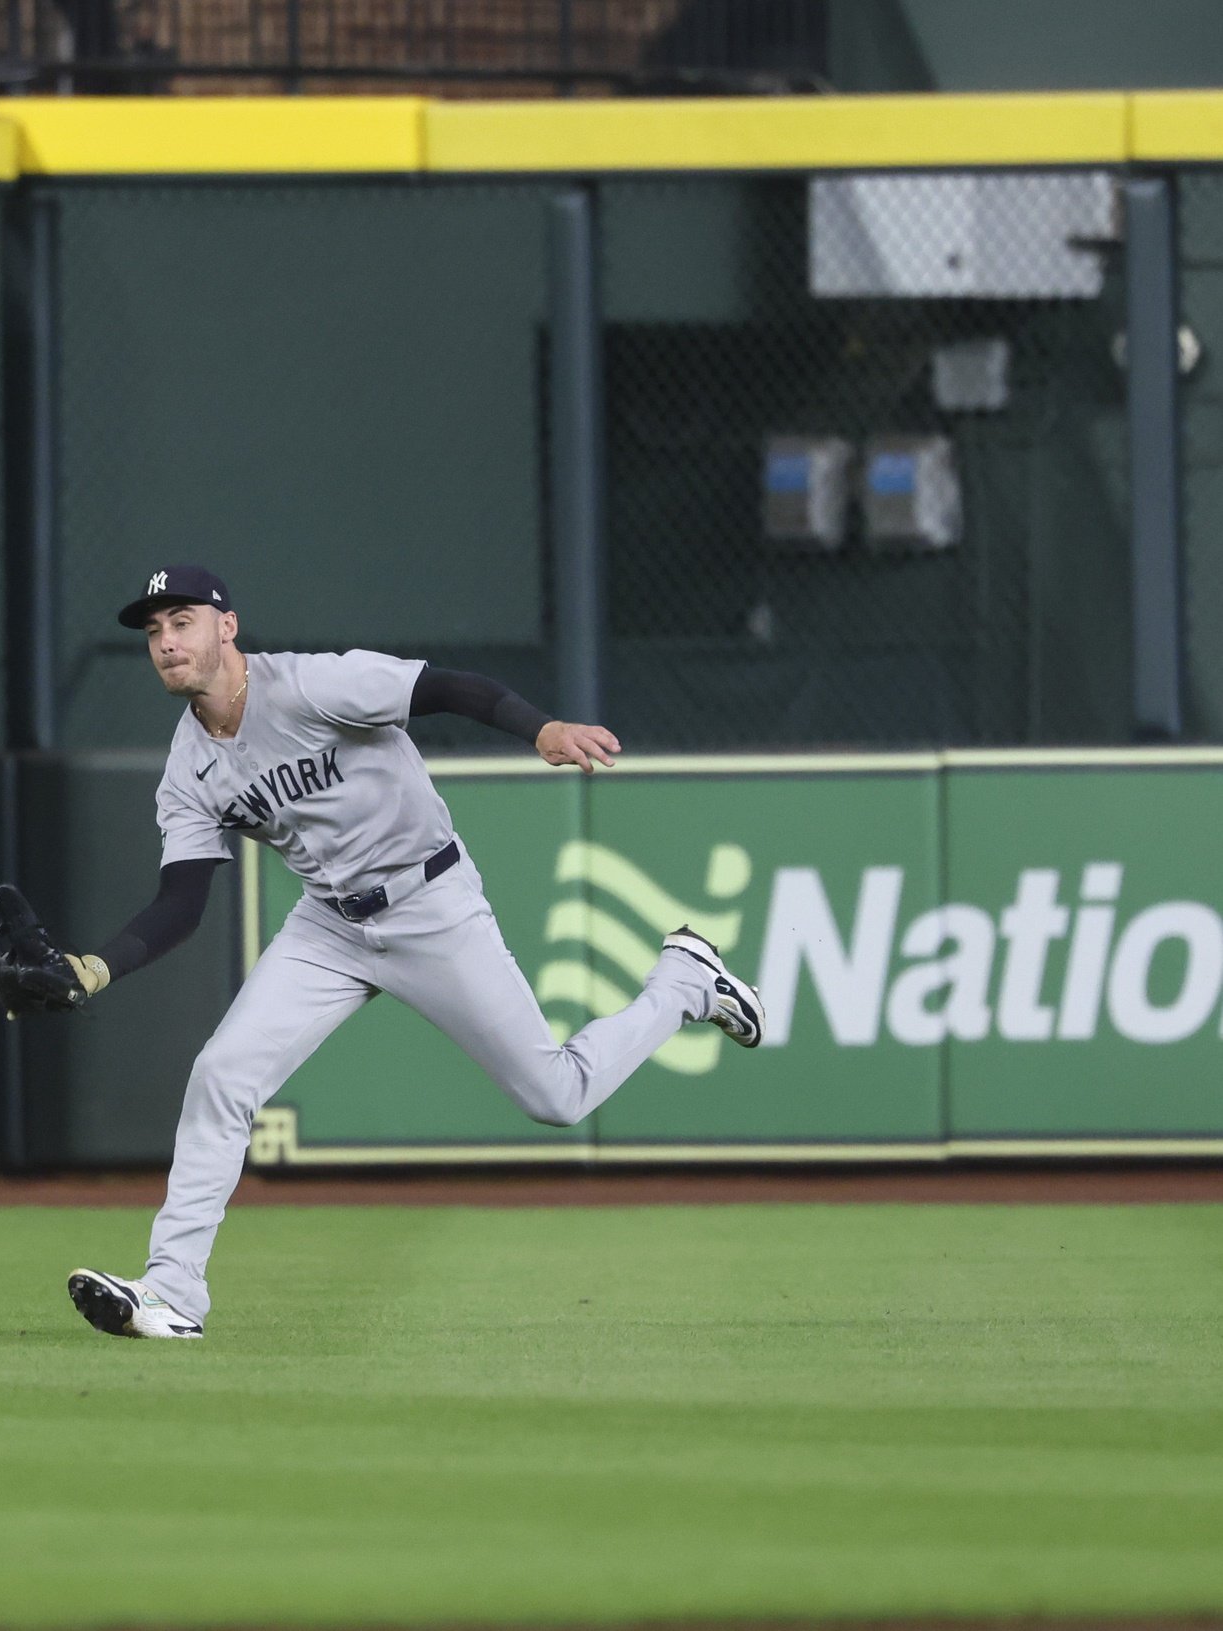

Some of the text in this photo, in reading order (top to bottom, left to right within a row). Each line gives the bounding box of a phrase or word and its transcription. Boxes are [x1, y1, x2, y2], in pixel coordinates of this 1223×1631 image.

[147, 570, 169, 596] NY
[259, 746, 345, 808] YORK
[758, 861, 1223, 1047] Natio
